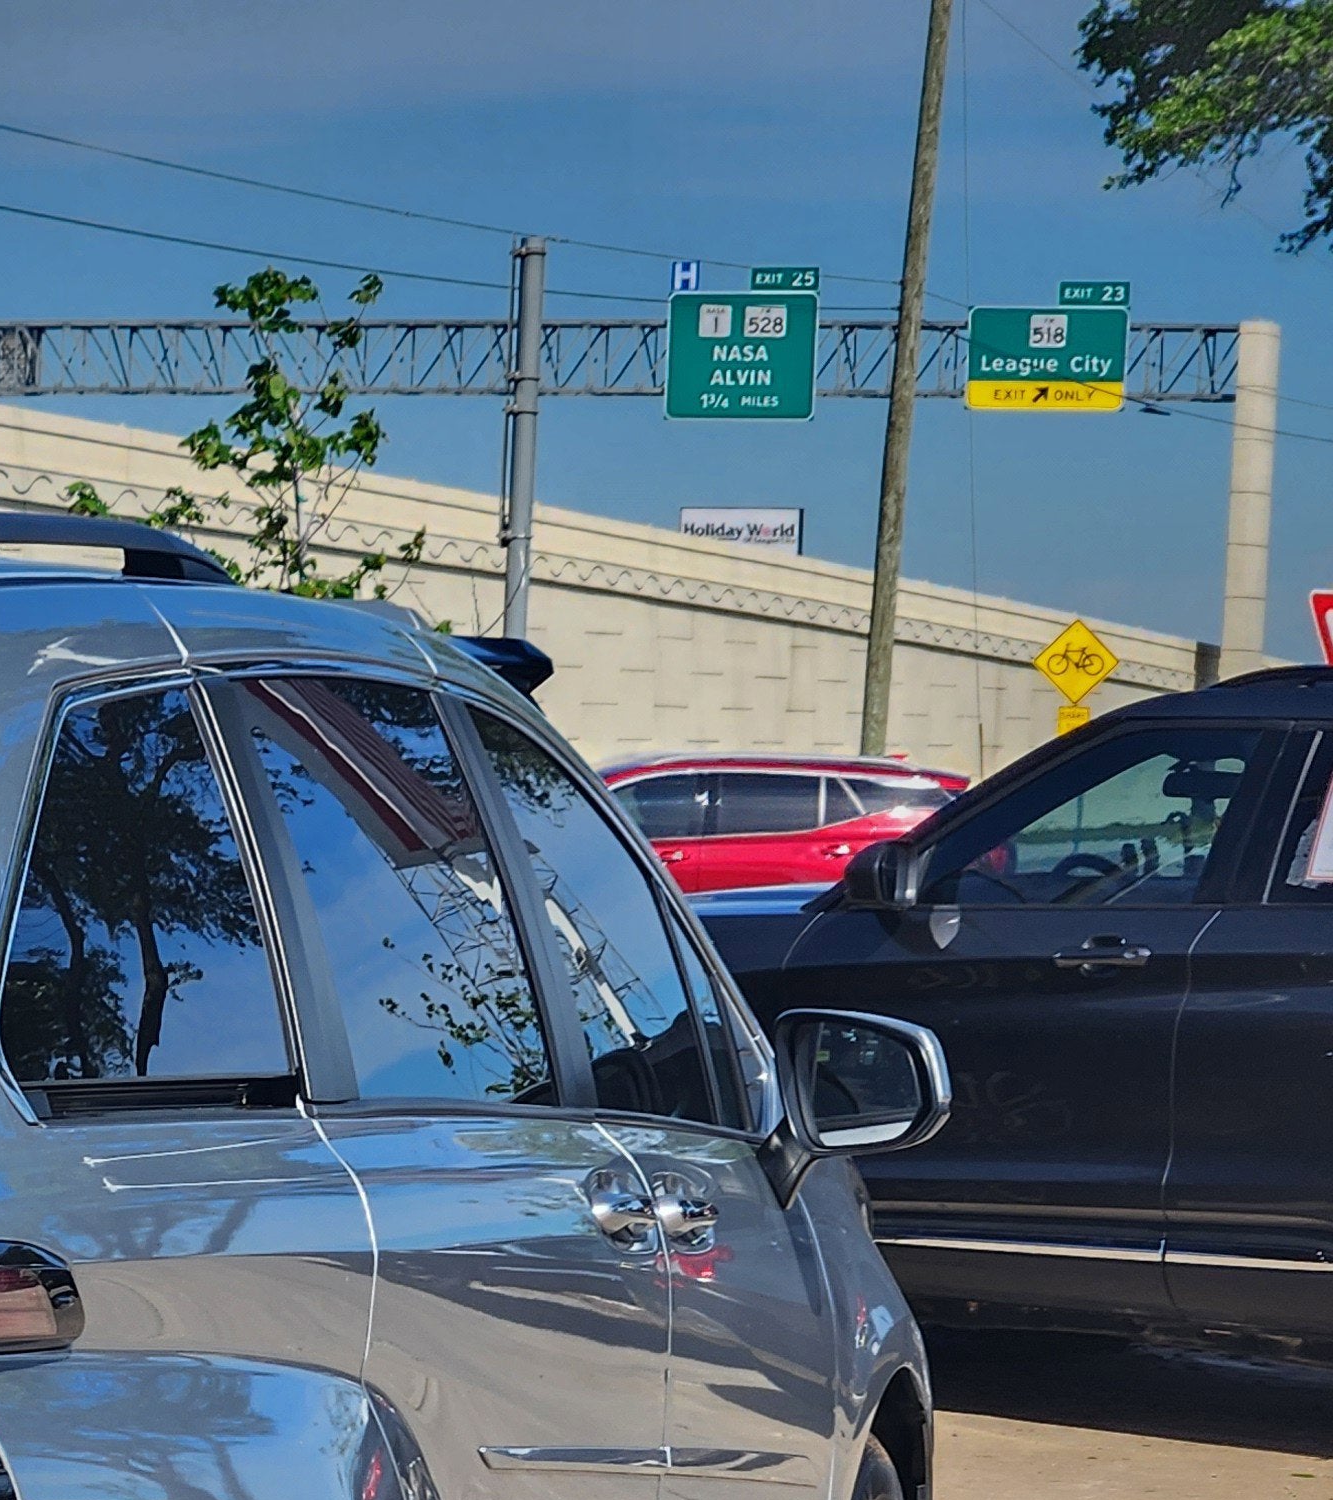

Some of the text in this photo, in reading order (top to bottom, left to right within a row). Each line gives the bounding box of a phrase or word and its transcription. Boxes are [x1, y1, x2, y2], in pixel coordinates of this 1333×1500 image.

[755, 271, 815, 287] EXIT 25
[1064, 285, 1125, 301] EXIT 23
[747, 316, 784, 334] 528
[1032, 326, 1064, 344] 518
[712, 345, 769, 362] NASA
[980, 354, 1113, 377] League City
[709, 369, 772, 386] ALVIN
[740, 396, 780, 408] MILES
[993, 389, 1097, 401] EXIT ONLY
[683, 523, 795, 540] Holiday World
